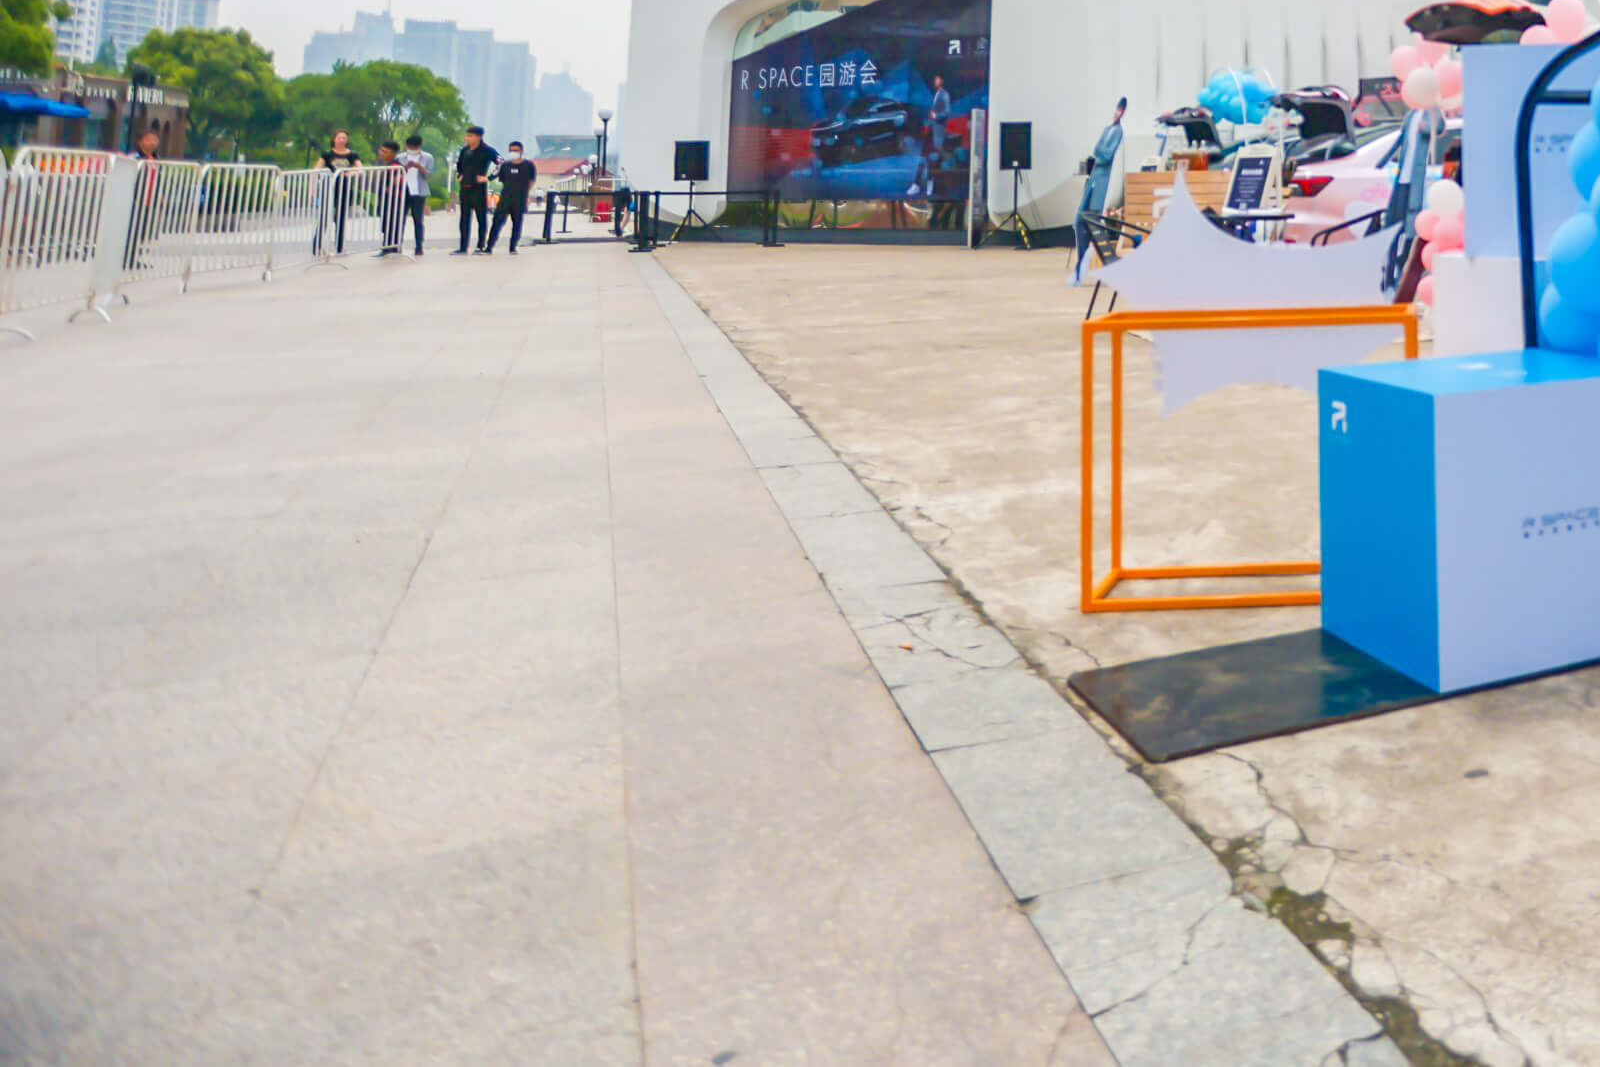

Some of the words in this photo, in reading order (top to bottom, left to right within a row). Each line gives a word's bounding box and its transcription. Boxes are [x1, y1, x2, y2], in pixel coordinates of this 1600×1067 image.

[740, 70, 749, 91] R
[758, 65, 814, 89] SPACE
[819, 59, 878, 87] 园游会
